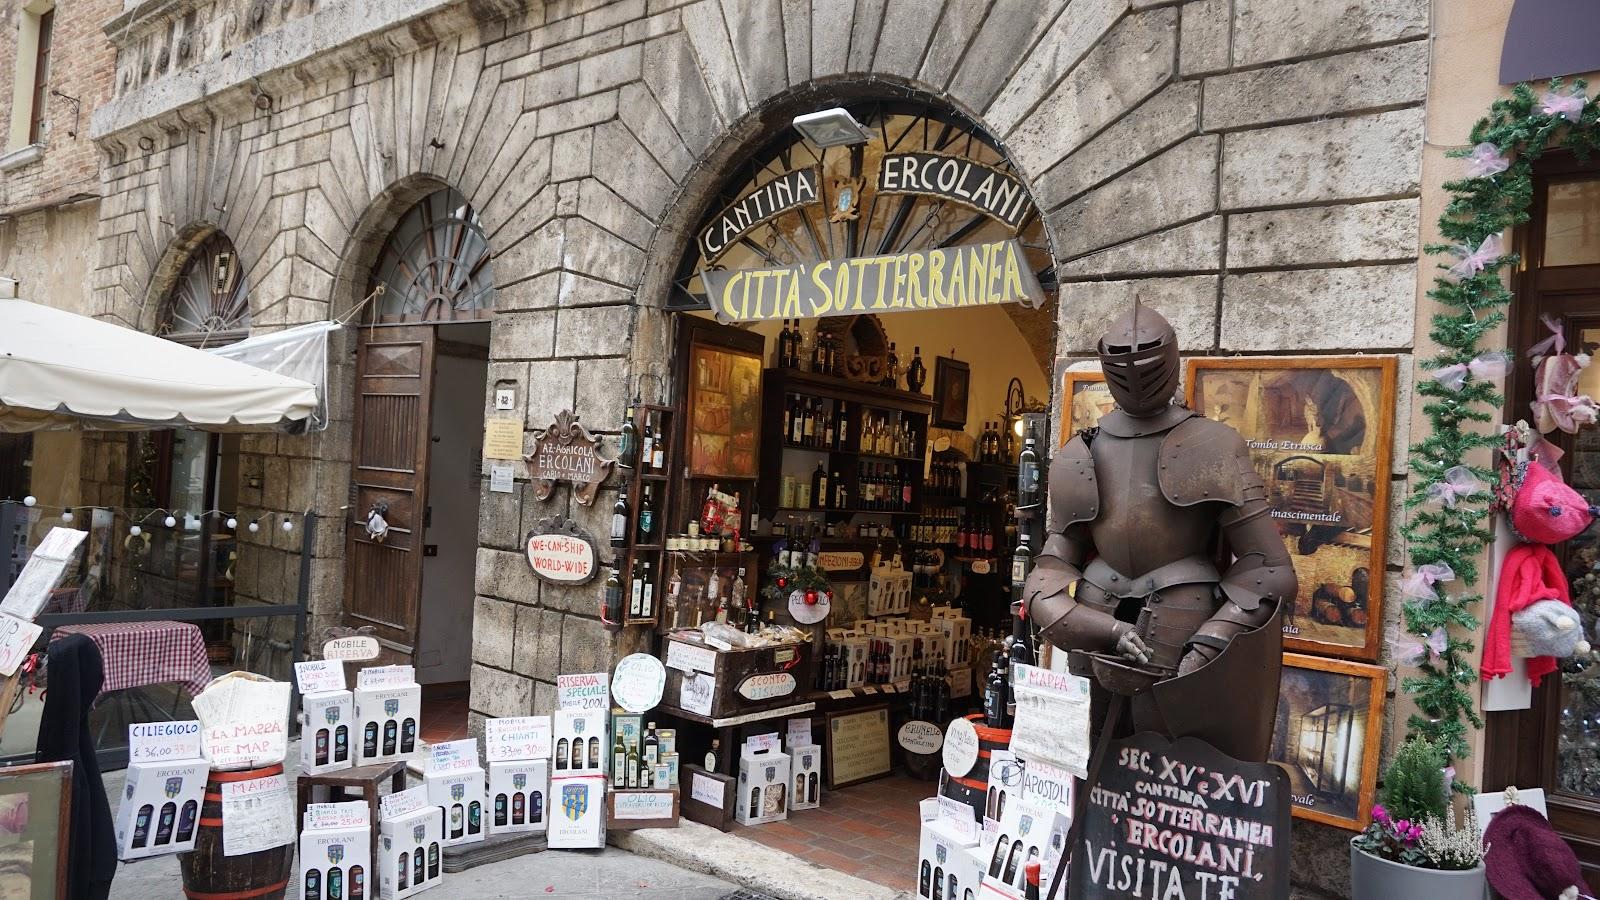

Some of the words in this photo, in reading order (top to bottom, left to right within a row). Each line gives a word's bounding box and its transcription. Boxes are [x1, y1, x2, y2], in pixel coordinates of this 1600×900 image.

[704, 170, 815, 254] CANTINA
[883, 157, 1026, 222] ERCOLANI
[808, 241, 1028, 318] SOTTERRANEA
[1246, 439, 1278, 451] Tomba
[1281, 439, 1323, 452] Etrusca
[539, 455, 595, 474] ERCOLANI
[568, 472, 590, 481] MARCO
[1270, 508, 1341, 522] inascimentale
[1282, 624, 1298, 634] aia
[333, 640, 367, 648] NOBILE
[327, 649, 373, 659] RISERVA
[558, 676, 599, 688] RISERVA
[750, 674, 787, 686] SCONTO
[1029, 670, 1068, 692] MAPPA
[566, 686, 606, 697] SPECIALE
[132, 724, 198, 737] CILIEGIOLO
[212, 730, 229, 740] LA
[233, 722, 282, 738] MAPPA
[904, 723, 941, 736] BRUNELLO
[502, 732, 538, 741] CHIANTI
[208, 746, 230, 754] THE
[234, 741, 270, 754] MAP
[1119, 747, 1154, 775] SEC.
[156, 768, 196, 778] ERCOLANI
[232, 778, 280, 795] MAPPA
[1024, 773, 1070, 806] APOSTOLI
[628, 794, 656, 803] OLIO
[1135, 781, 1209, 810] CANTINA
[1291, 794, 1314, 806] vale
[1131, 797, 1273, 848] SOTTERRANEA
[317, 836, 355, 845] ERCOLANI
